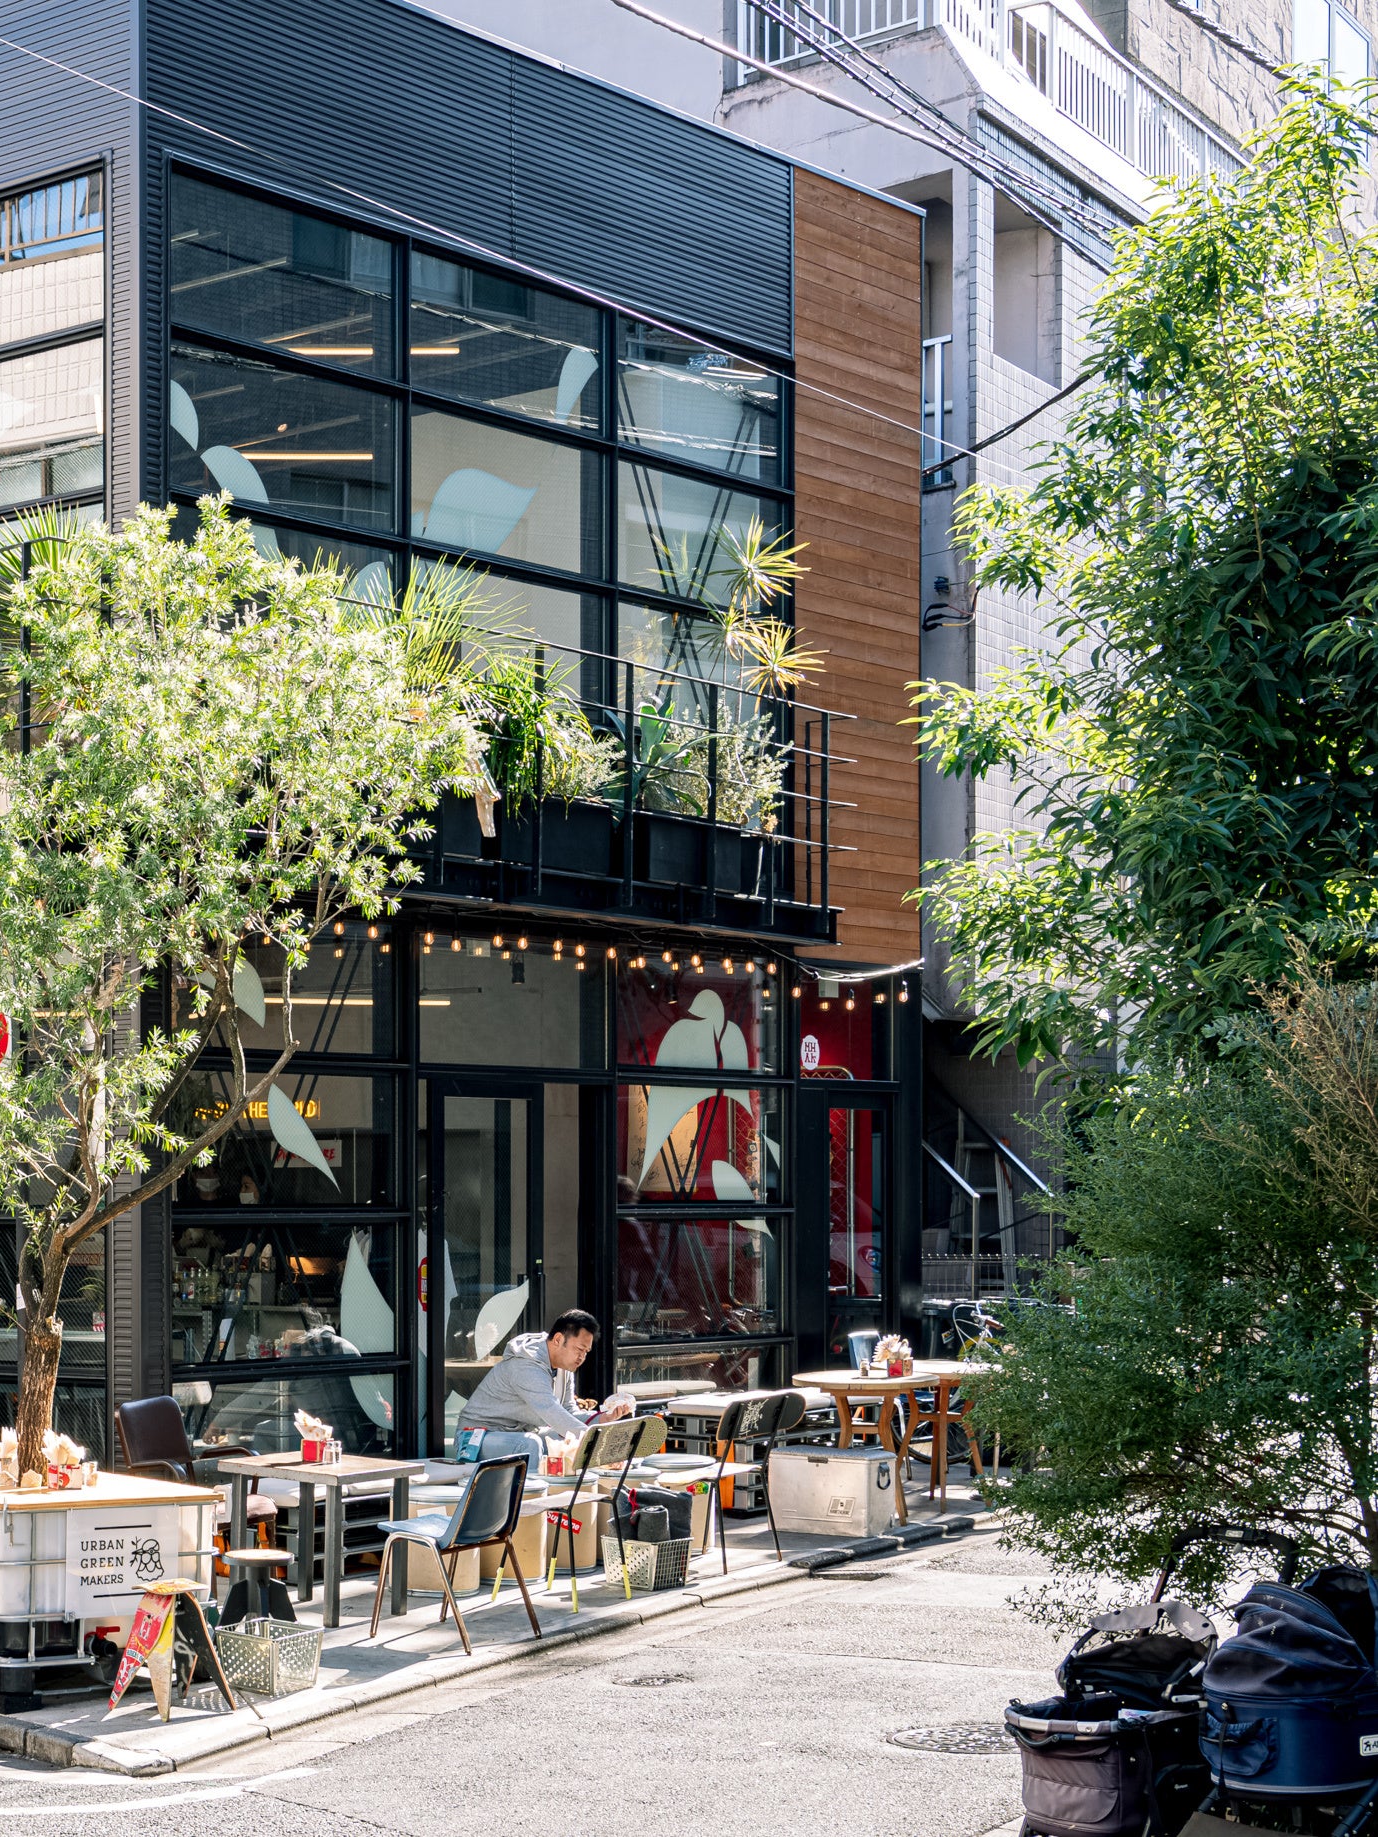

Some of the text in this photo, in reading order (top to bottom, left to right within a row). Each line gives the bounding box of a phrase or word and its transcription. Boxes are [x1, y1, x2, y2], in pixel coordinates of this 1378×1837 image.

[80, 1539, 124, 1551] URBAN
[80, 1556, 124, 1569] GREEN
[80, 1573, 124, 1586] MAKERS
